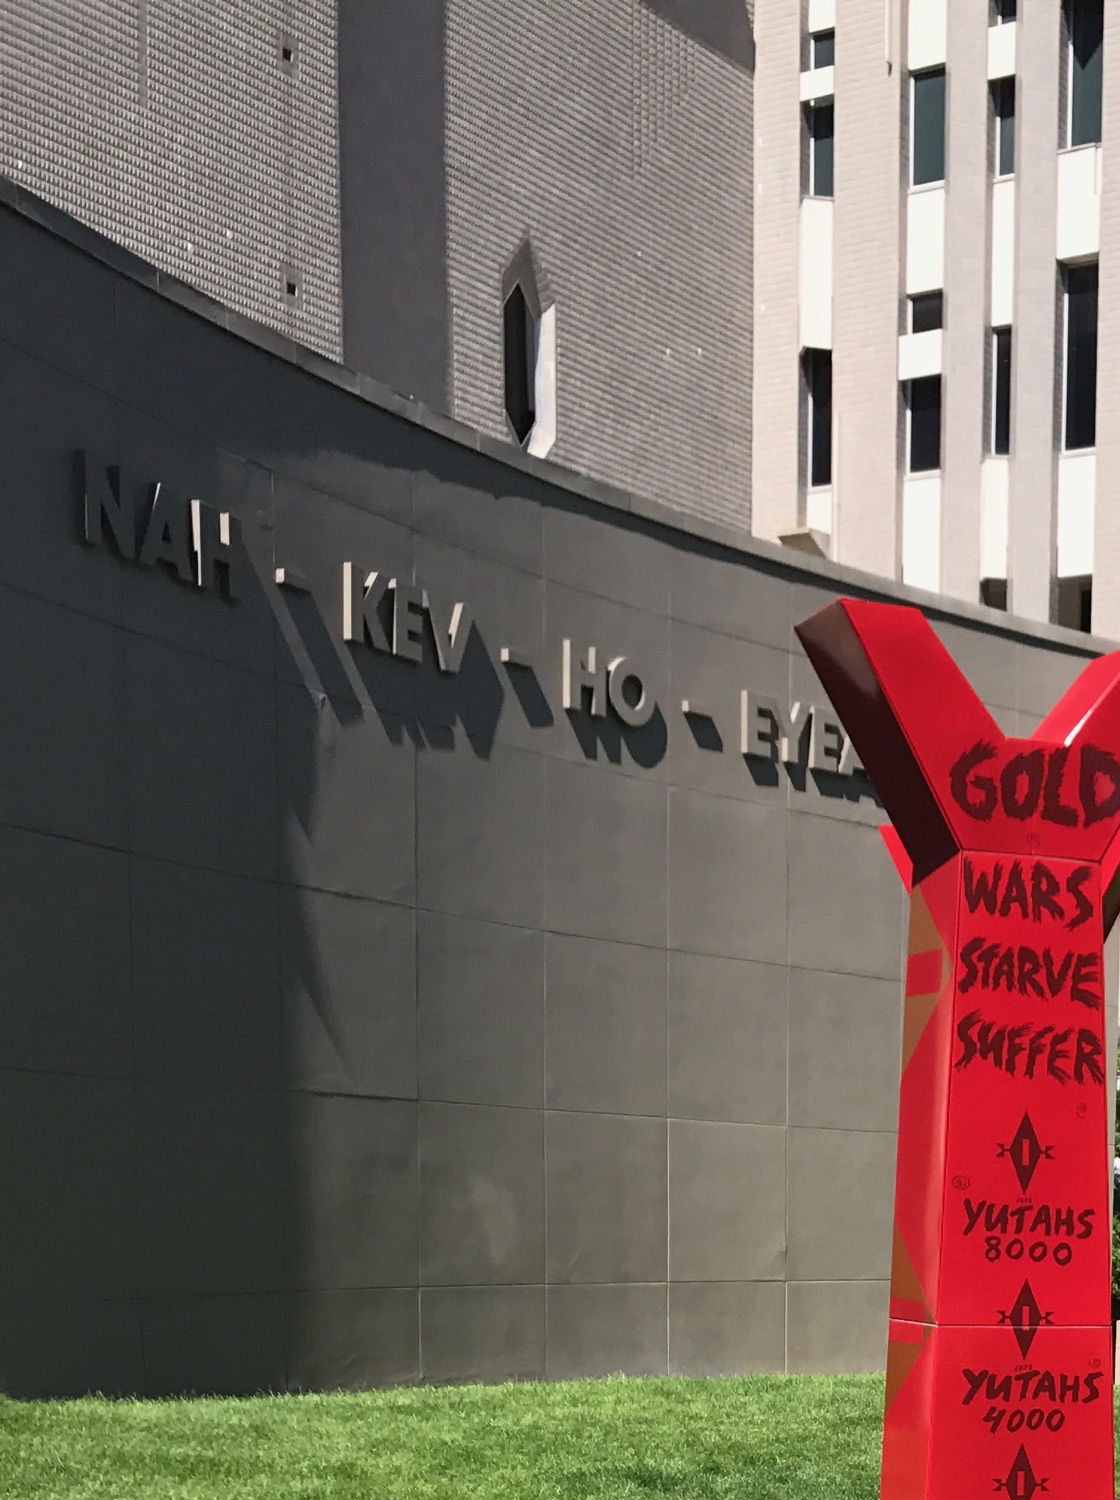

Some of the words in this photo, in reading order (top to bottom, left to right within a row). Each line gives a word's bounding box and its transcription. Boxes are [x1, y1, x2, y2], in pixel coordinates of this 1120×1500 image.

[343, 562, 474, 674] KEV
[562, 639, 657, 727] HO
[963, 857, 1094, 931] WARS
[958, 936, 1101, 1010] STARVE
[955, 1009, 1105, 1085] SUFFER
[963, 1198, 1095, 1239] YUTAHS
[985, 1236, 1073, 1266] 8000
[962, 1368, 1104, 1405] YUTAHS
[982, 1406, 1065, 1433] 4000
